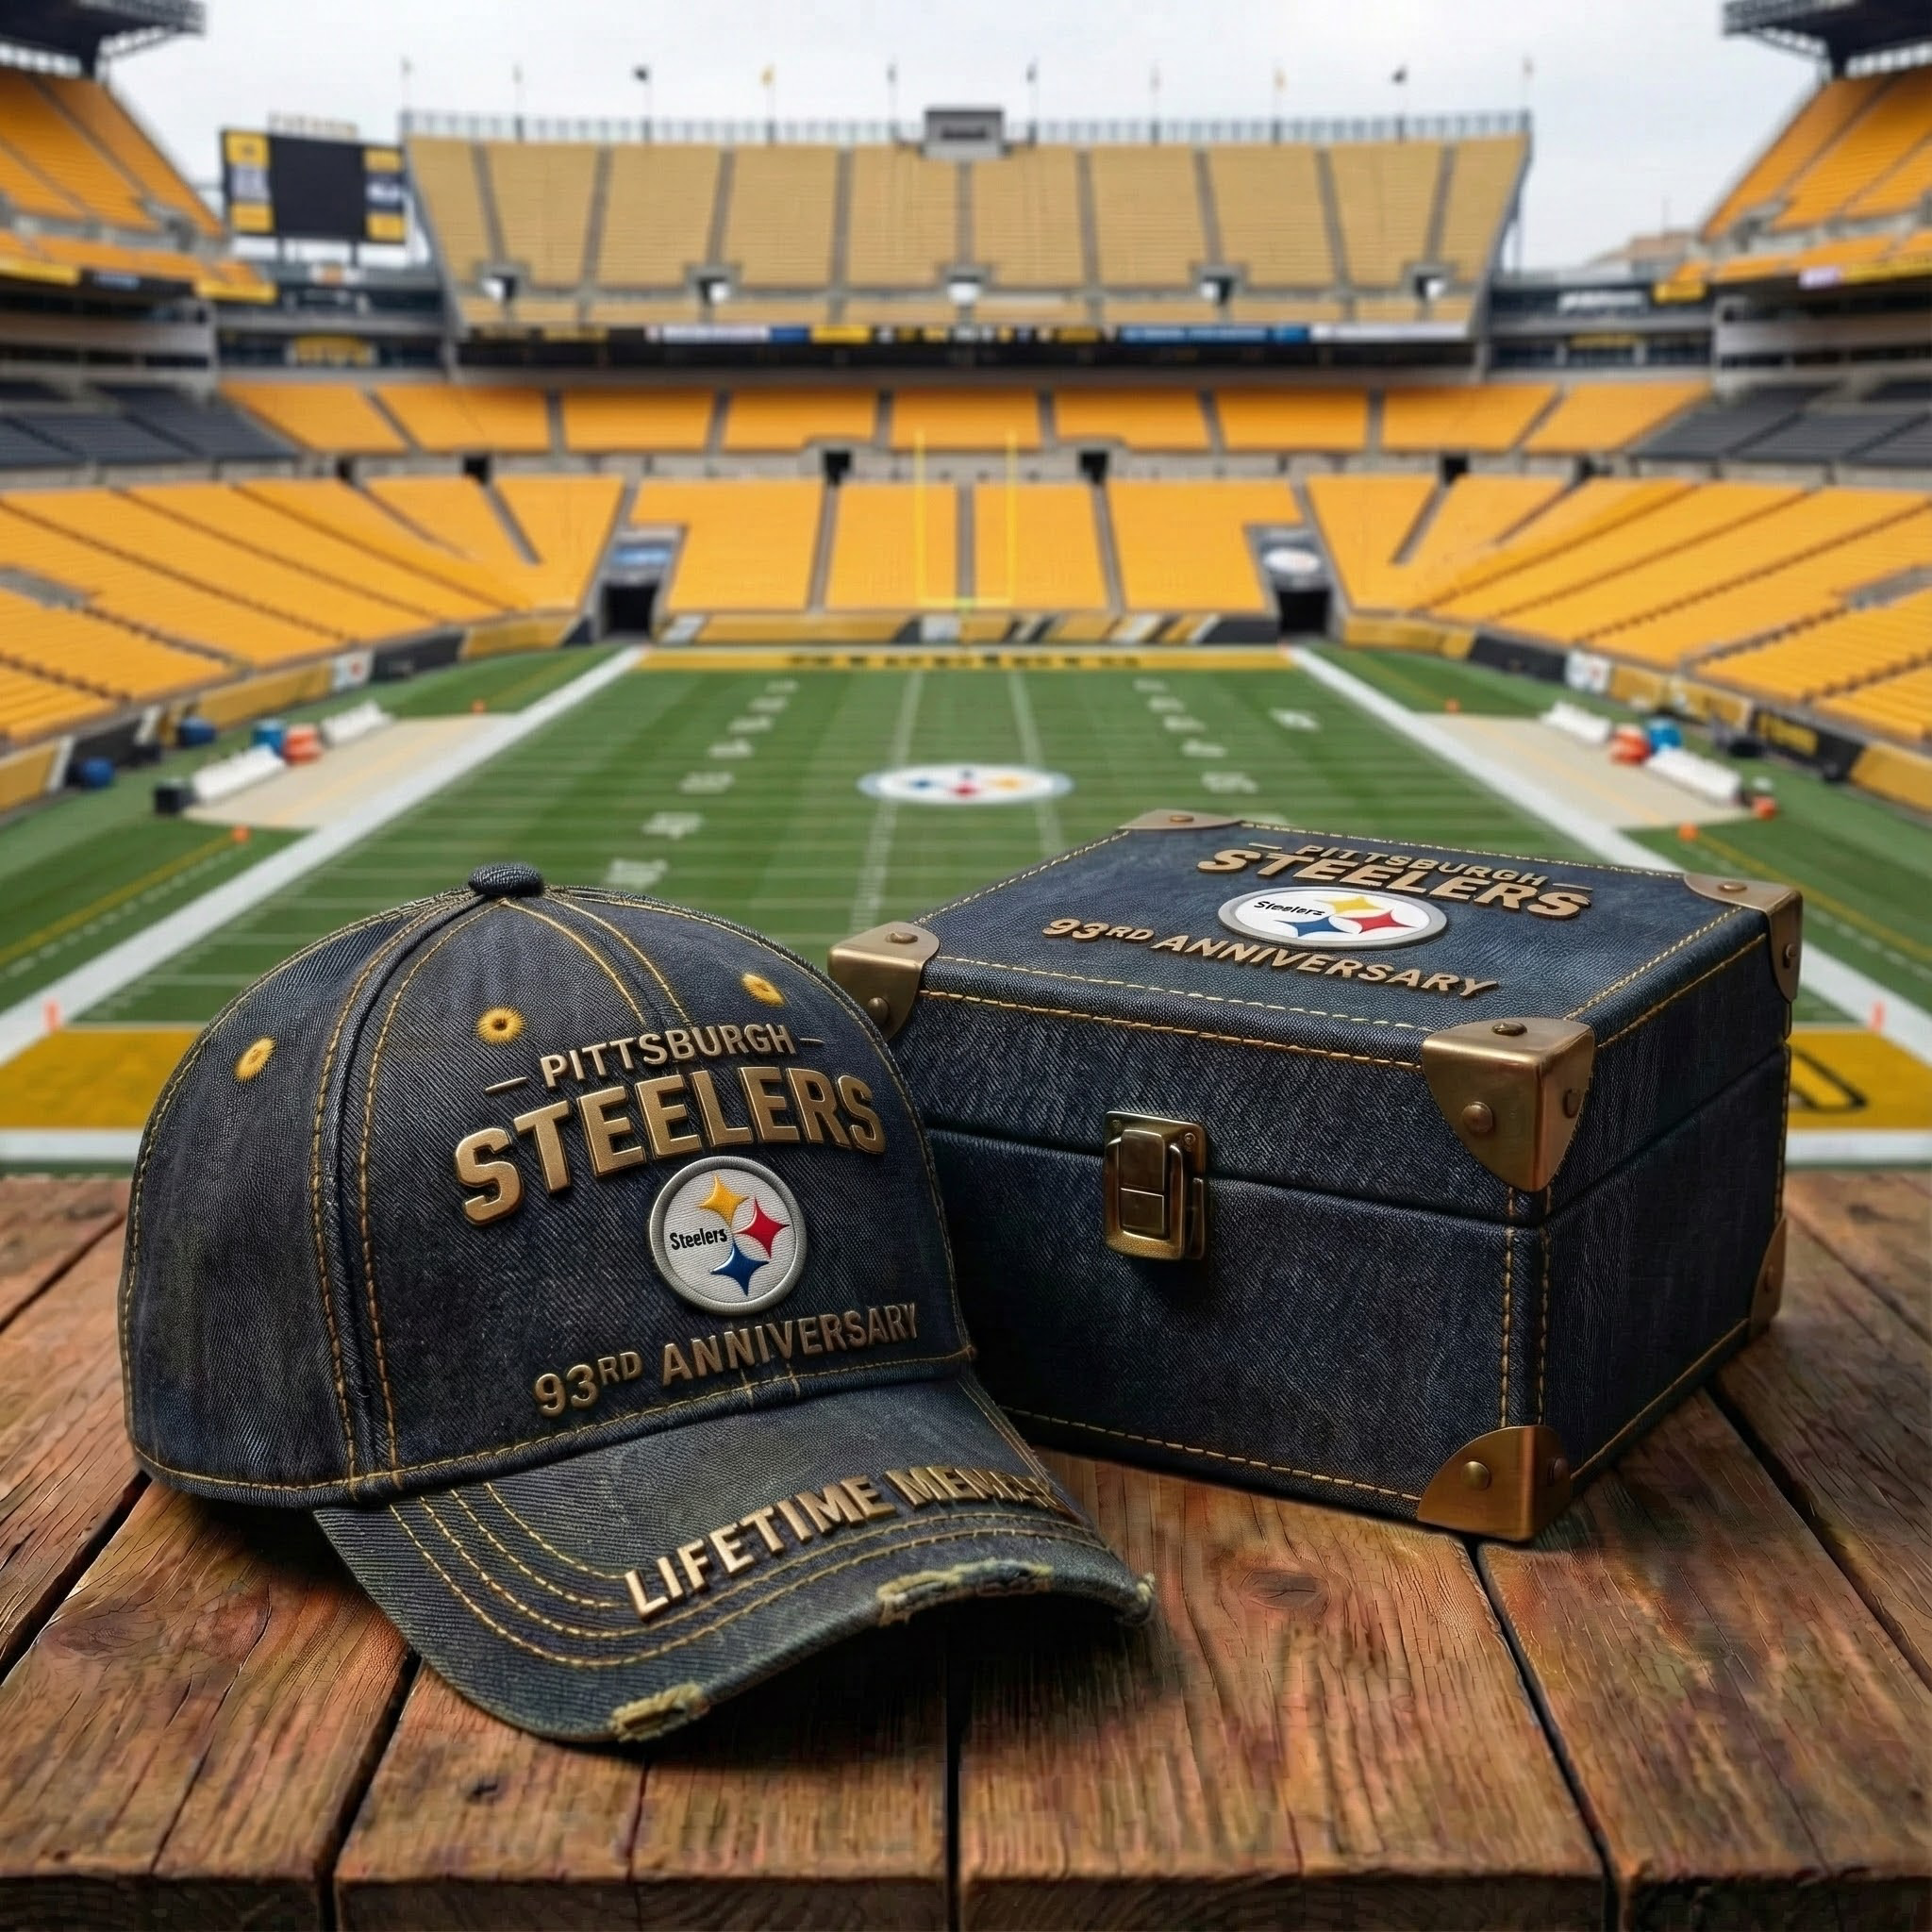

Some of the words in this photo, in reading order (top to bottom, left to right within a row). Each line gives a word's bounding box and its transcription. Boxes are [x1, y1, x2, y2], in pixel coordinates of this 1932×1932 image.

[1196, 848, 1592, 920] STEELERS
[1294, 844, 1548, 887] PITTSBURGH
[1042, 918, 1155, 942] 93RD
[1151, 934, 1499, 998] ANNIVERSARY
[541, 1024, 796, 1089] PITTSBURGH
[455, 1066, 885, 1225] STEELERS
[669, 1227, 727, 1250] Steelers
[534, 1352, 643, 1417] 93RD
[662, 1303, 919, 1387] ANNIVERSARY
[625, 1475, 897, 1622] LIFETIME
